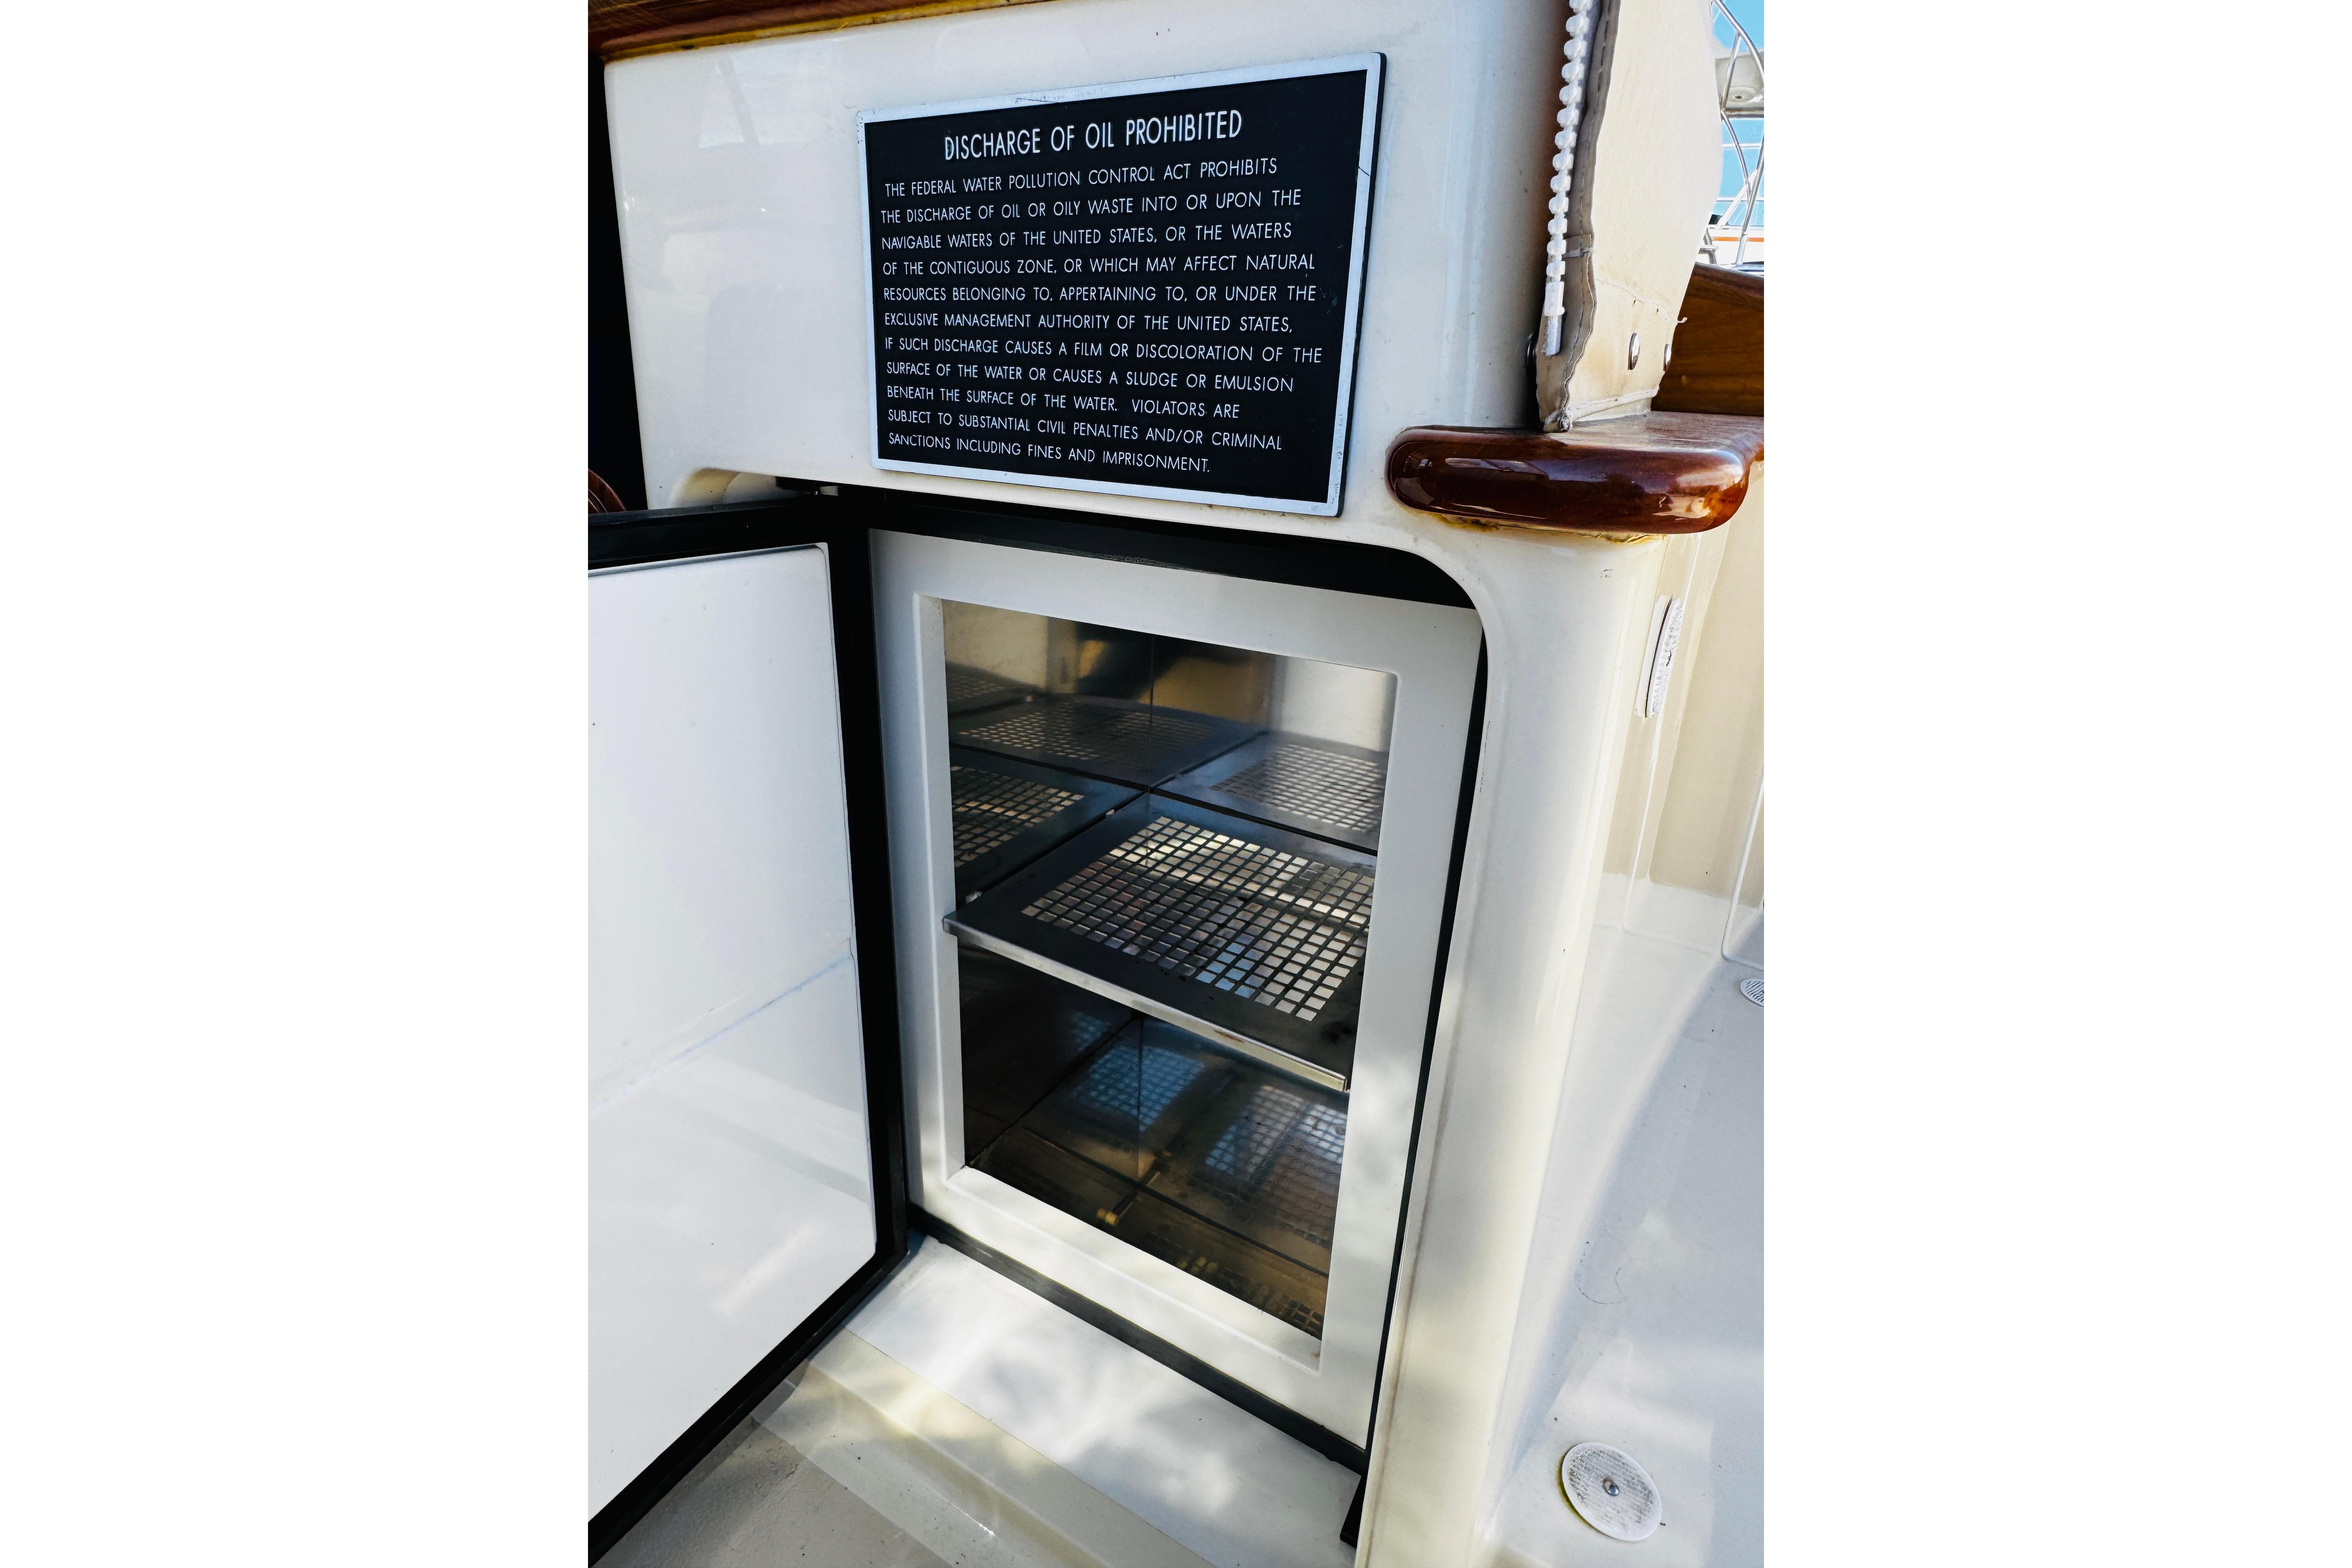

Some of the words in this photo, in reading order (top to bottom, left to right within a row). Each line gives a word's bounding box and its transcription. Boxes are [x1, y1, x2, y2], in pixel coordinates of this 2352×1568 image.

[945, 128, 1040, 160] DISCHARGE
[1051, 125, 1074, 151] OF
[1085, 122, 1114, 149] OIL
[1126, 110, 1242, 146] PROHIBITED
[885, 183, 905, 197] THE
[912, 180, 956, 195] FEDERAL
[963, 176, 1002, 192] WATER
[1009, 171, 1080, 189] POLLUTION
[1088, 166, 1155, 185] CONTROL
[1164, 163, 1191, 180] ACT
[1200, 158, 1277, 178] PROHIBITS
[881, 210, 901, 223] THE
[907, 206, 971, 222] DISCHARGE
[978, 205, 994, 219] OF
[1002, 204, 1020, 218] OIL
[1028, 202, 1045, 217] OR
[1054, 201, 1080, 216] OILY
[1088, 198, 1133, 214] WASTE
[1142, 196, 1177, 212] INTO
[1186, 194, 1207, 210] OR
[1216, 191, 1261, 208] UPON
[1272, 189, 1301, 206] THE
[882, 234, 942, 250] NAVIGABLE
[948, 233, 992, 248] WATERS
[999, 232, 1015, 246] OF
[1023, 231, 1046, 245] THE
[1054, 229, 1101, 245] UNITED
[1110, 228, 1157, 243] STATES,
[1166, 226, 1186, 241] OR
[1195, 225, 1222, 240] THE
[1232, 222, 1292, 240] WATERS
[883, 262, 897, 275] OF
[903, 262, 923, 275] THE
[930, 260, 1010, 275] CONTIGUOUS
[1017, 259, 1057, 274] ZONE,
[1064, 259, 1082, 273] OR
[1090, 257, 1138, 272] WHICH
[1146, 256, 1176, 272] MAY
[1184, 255, 1237, 271] AFFECT
[1246, 254, 1315, 270] NATURAL
[884, 287, 946, 301] RESOURCES
[953, 287, 1026, 301] BELONGING
[1033, 287, 1053, 301] TO,
[1059, 287, 1156, 301] APPERTAINING
[1165, 286, 1187, 302] TO,
[1196, 286, 1216, 301] OR
[1225, 286, 1276, 301] UNDER
[1287, 285, 1316, 301] THE
[885, 313, 938, 326] EXCLUSIVE
[945, 313, 1031, 327] MANAGEMENT
[1038, 314, 1110, 329] AUTHORITY
[1117, 315, 1135, 329] OF
[1144, 315, 1169, 330] THE
[1178, 315, 1230, 331] UNITED
[1240, 317, 1292, 333] STATES,
[886, 337, 893, 349] IF
[899, 338, 928, 350] SUCH
[934, 338, 998, 353] DISCHARGE
[1005, 340, 1052, 355] CAUSES
[1059, 342, 1067, 355] A
[1074, 342, 1102, 356] FILM
[1110, 343, 1128, 357] OR
[1136, 344, 1253, 361] DISCOLORATION
[1262, 347, 1283, 362] OF
[1293, 348, 1322, 363] THE
[887, 362, 930, 375] SURFACE
[936, 364, 951, 376] OF
[957, 364, 978, 378] THE
[984, 366, 1022, 380] WATER
[1029, 368, 1046, 381] OR
[1053, 368, 1102, 383] CAUSES
[1109, 371, 1118, 384] A
[1126, 371, 1178, 387] SLUDGE
[1186, 374, 1206, 388] OR
[1215, 374, 1293, 392] EMULSION
[887, 385, 933, 400] BENEATH
[940, 388, 960, 401] THE
[966, 390, 1013, 405] SURFACE
[1020, 393, 1036, 406] OF
[1044, 394, 1066, 408] THE
[1073, 396, 1117, 411] WATER.
[1213, 404, 1240, 418] ARE
[888, 409, 931, 424] SUBJECT
[938, 413, 952, 425] TO
[959, 414, 1030, 431] SUBSTANTIAL
[1038, 420, 1066, 434] CIVIL
[1074, 422, 1138, 439] PENALTIES
[1146, 427, 1203, 444] AND/OR
[1212, 432, 1282, 450] CRIMINAL
[889, 432, 950, 449] SANCTIONS
[957, 438, 1021, 455] INCLUDING
[1028, 444, 1061, 459] FINES
[1068, 448, 1095, 462] AND
[1103, 451, 1209, 472] IMPRISONMENT.
